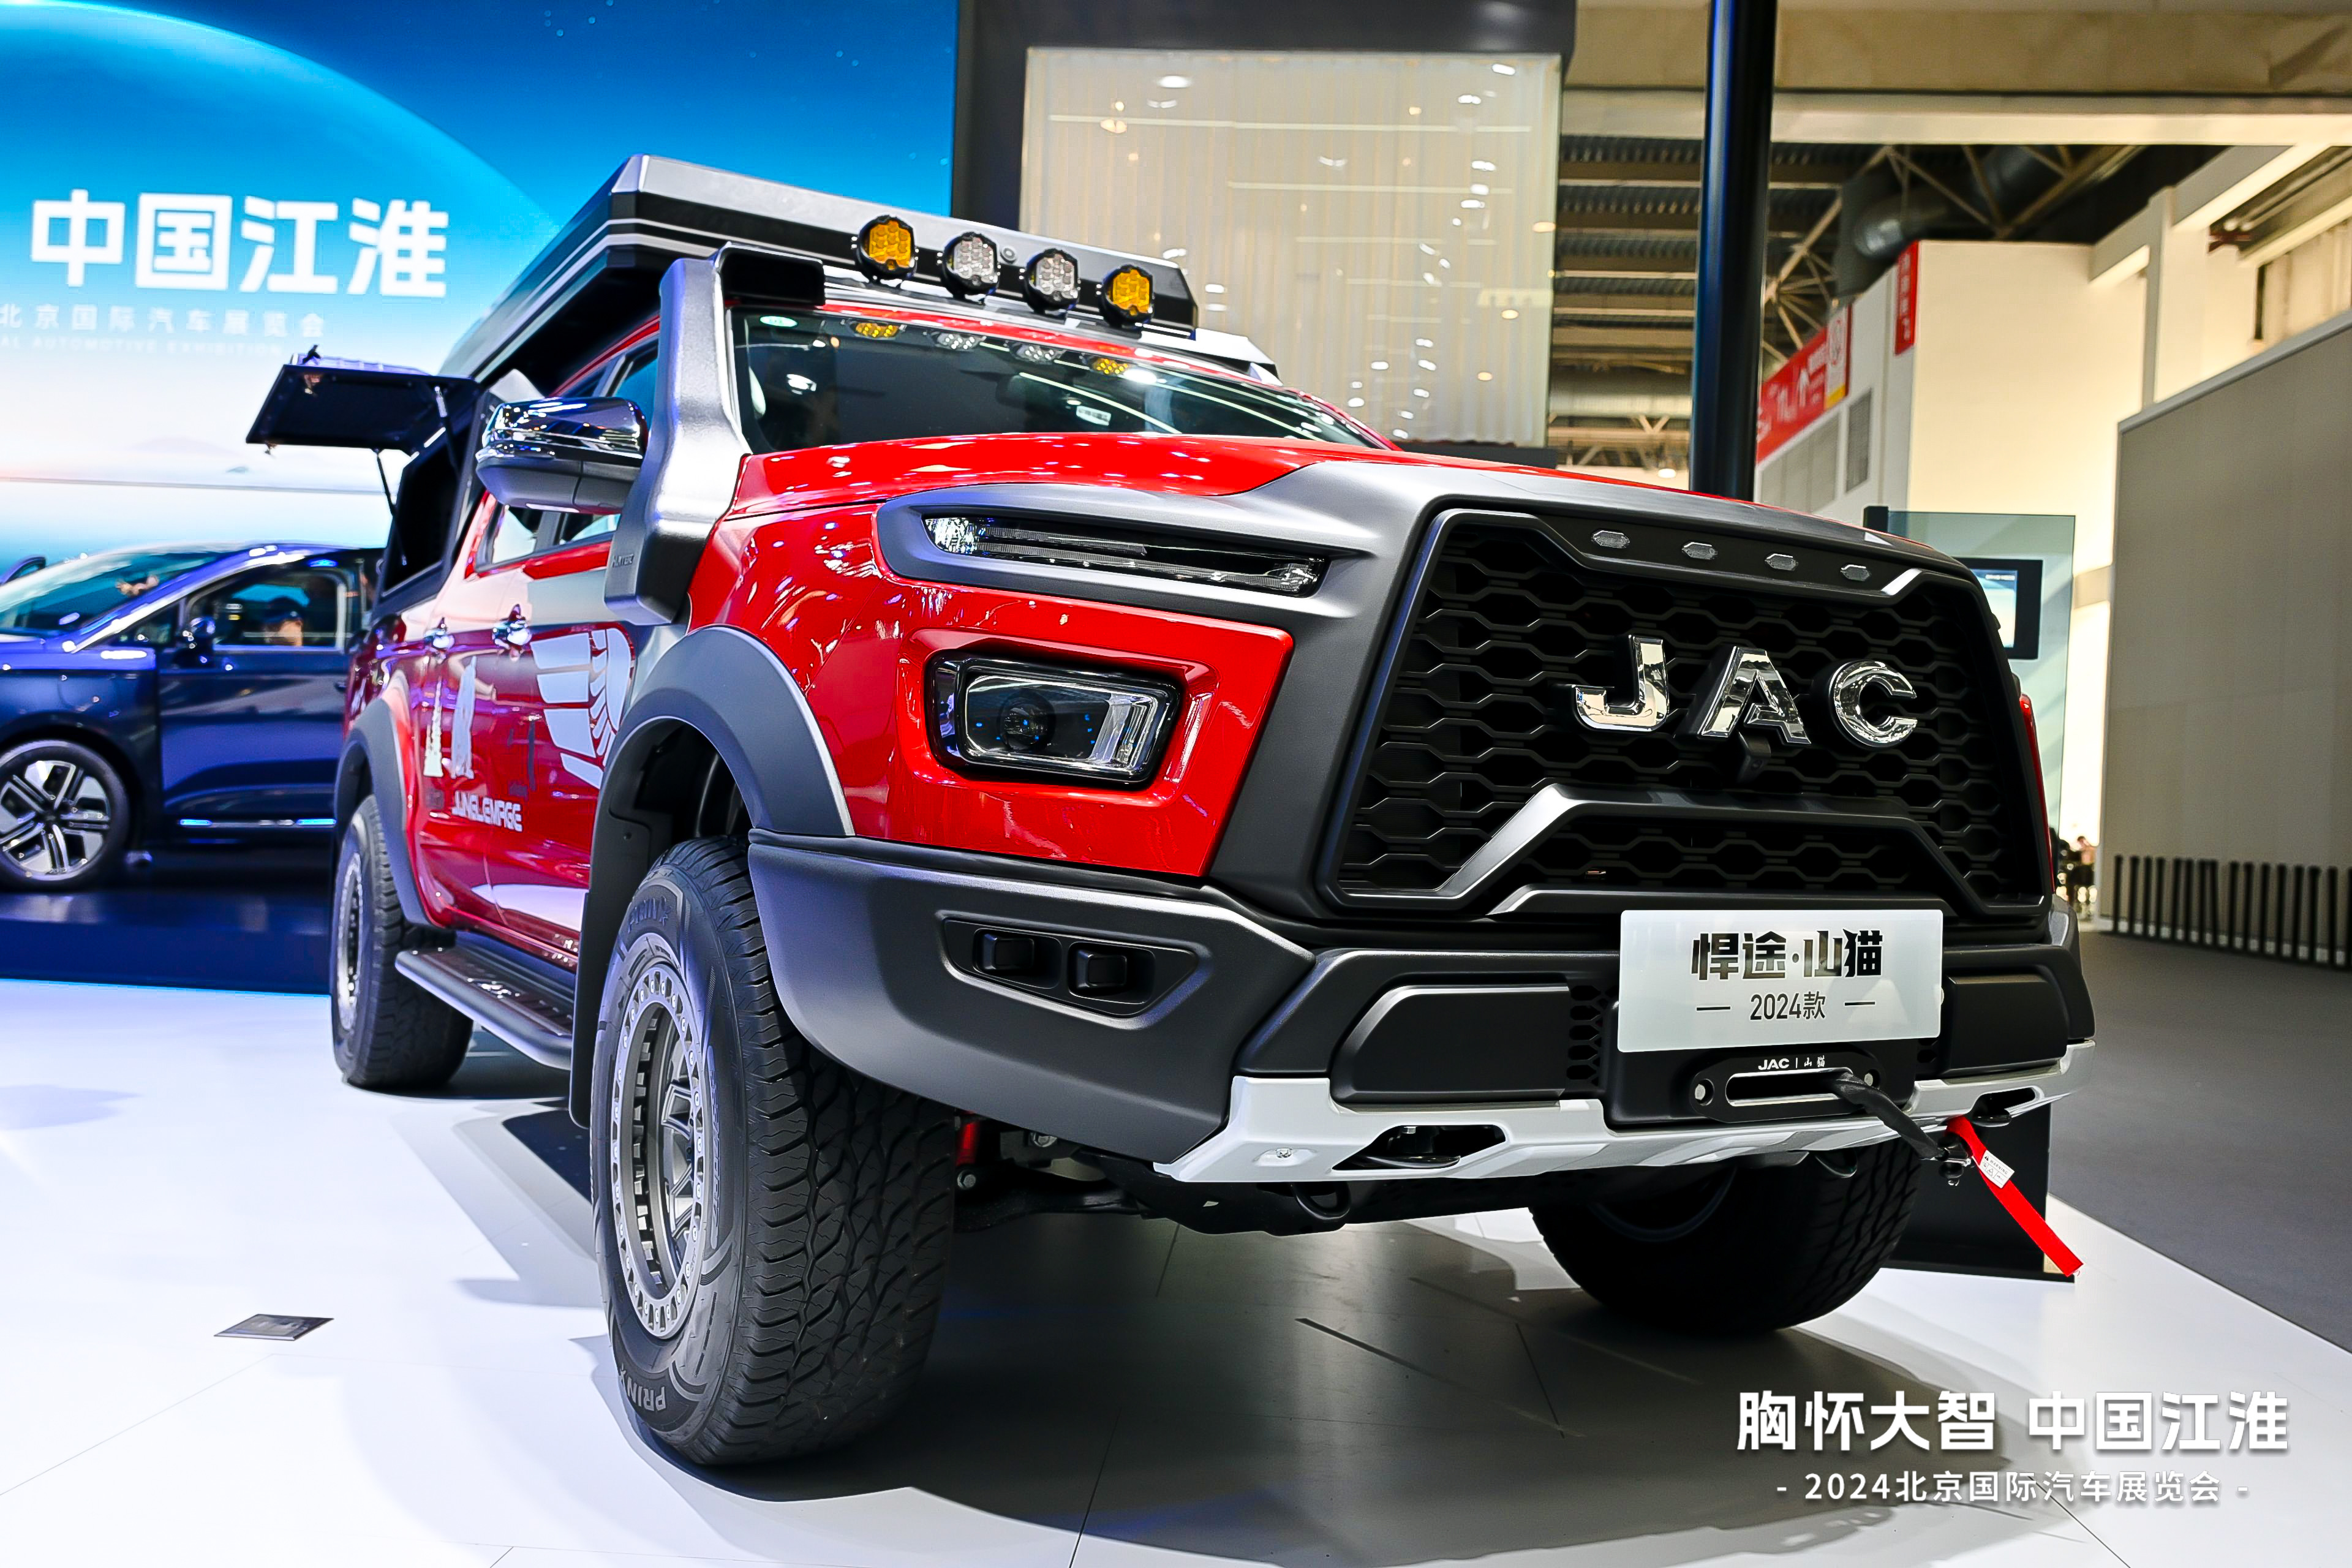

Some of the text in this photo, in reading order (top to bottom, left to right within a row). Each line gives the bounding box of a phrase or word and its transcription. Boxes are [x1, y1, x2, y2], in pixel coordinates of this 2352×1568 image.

[31, 189, 449, 298] 中国江淮
[1571, 634, 1918, 748] JAC
[1691, 929, 1883, 981] 悍途·山猫
[1750, 991, 1826, 1020] 2024款
[1758, 1058, 1790, 1070] JAC
[1989, 1159, 2009, 1175] WARNING
